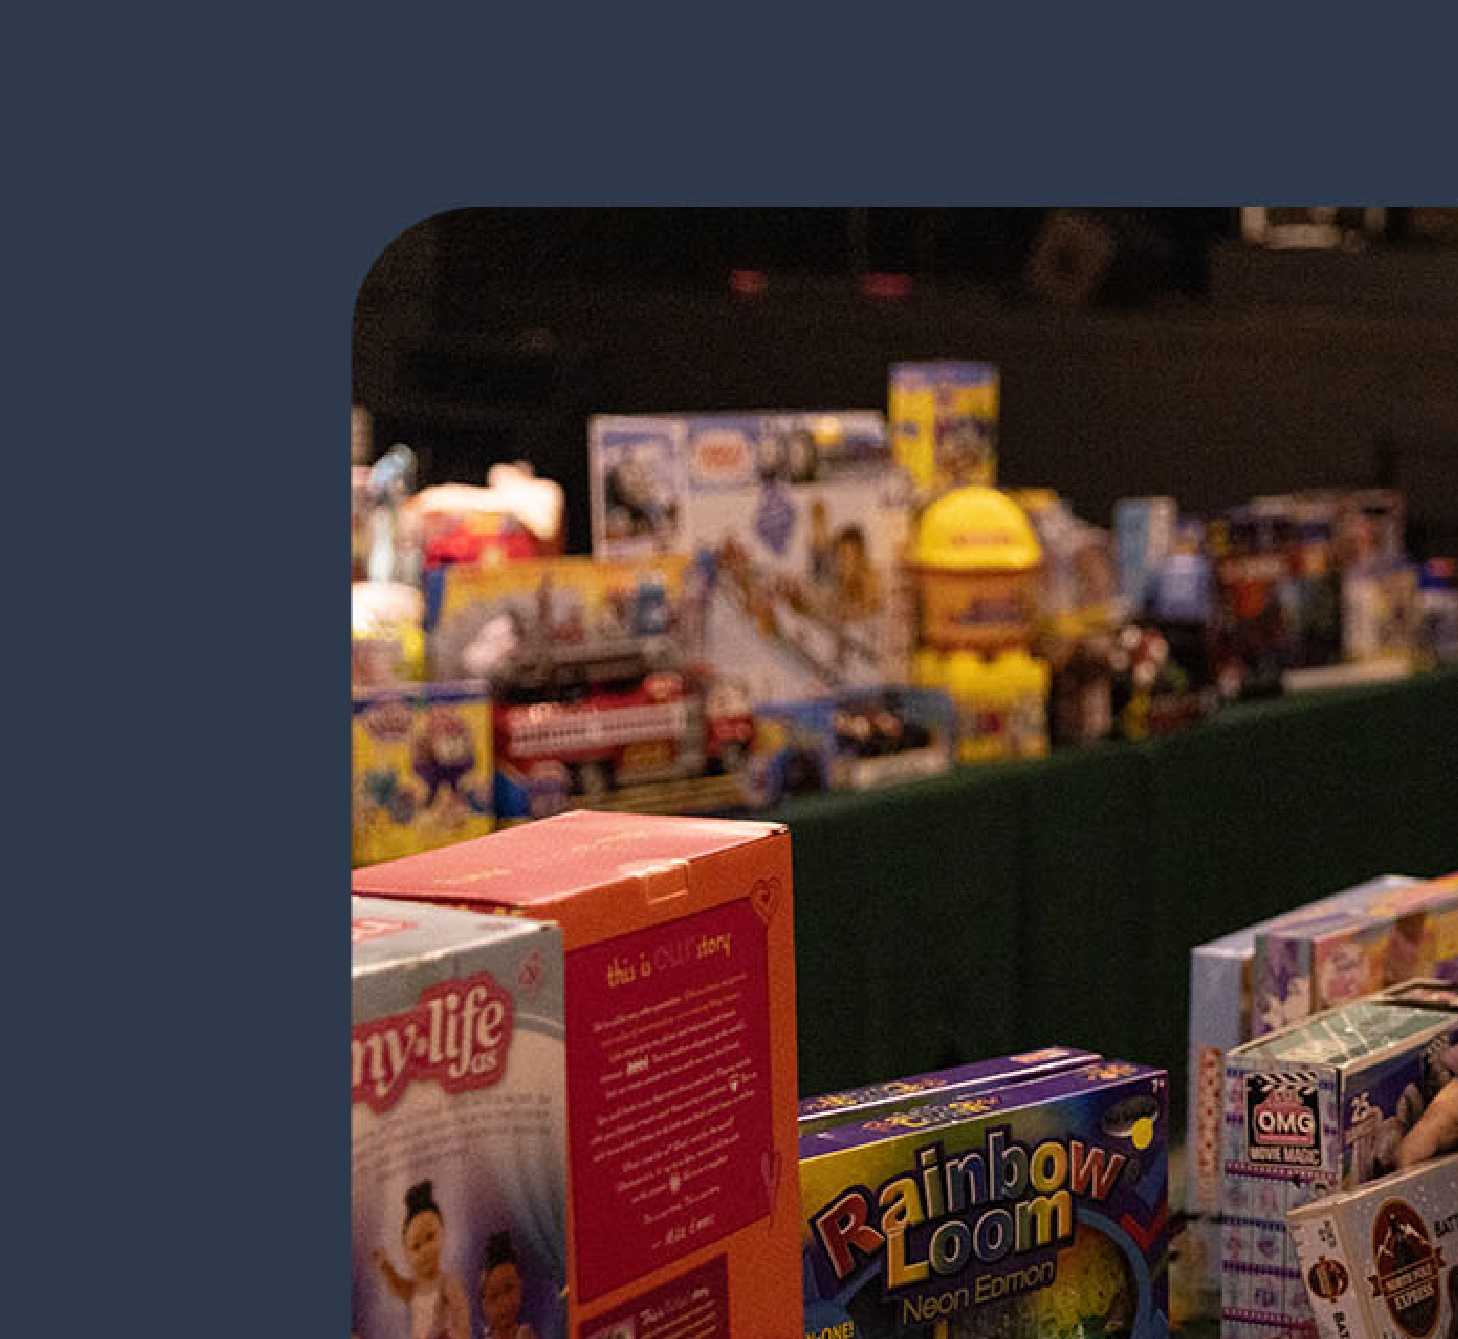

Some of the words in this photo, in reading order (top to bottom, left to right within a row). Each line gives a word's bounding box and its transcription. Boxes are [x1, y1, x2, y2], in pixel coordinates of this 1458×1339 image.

[428, 985, 505, 1078] life
[471, 1052, 498, 1074] as
[1257, 1111, 1314, 1133] OMG
[816, 1131, 1128, 1281] Rainbow
[885, 1186, 1072, 1290] Loom
[902, 1283, 971, 1326] Neon
